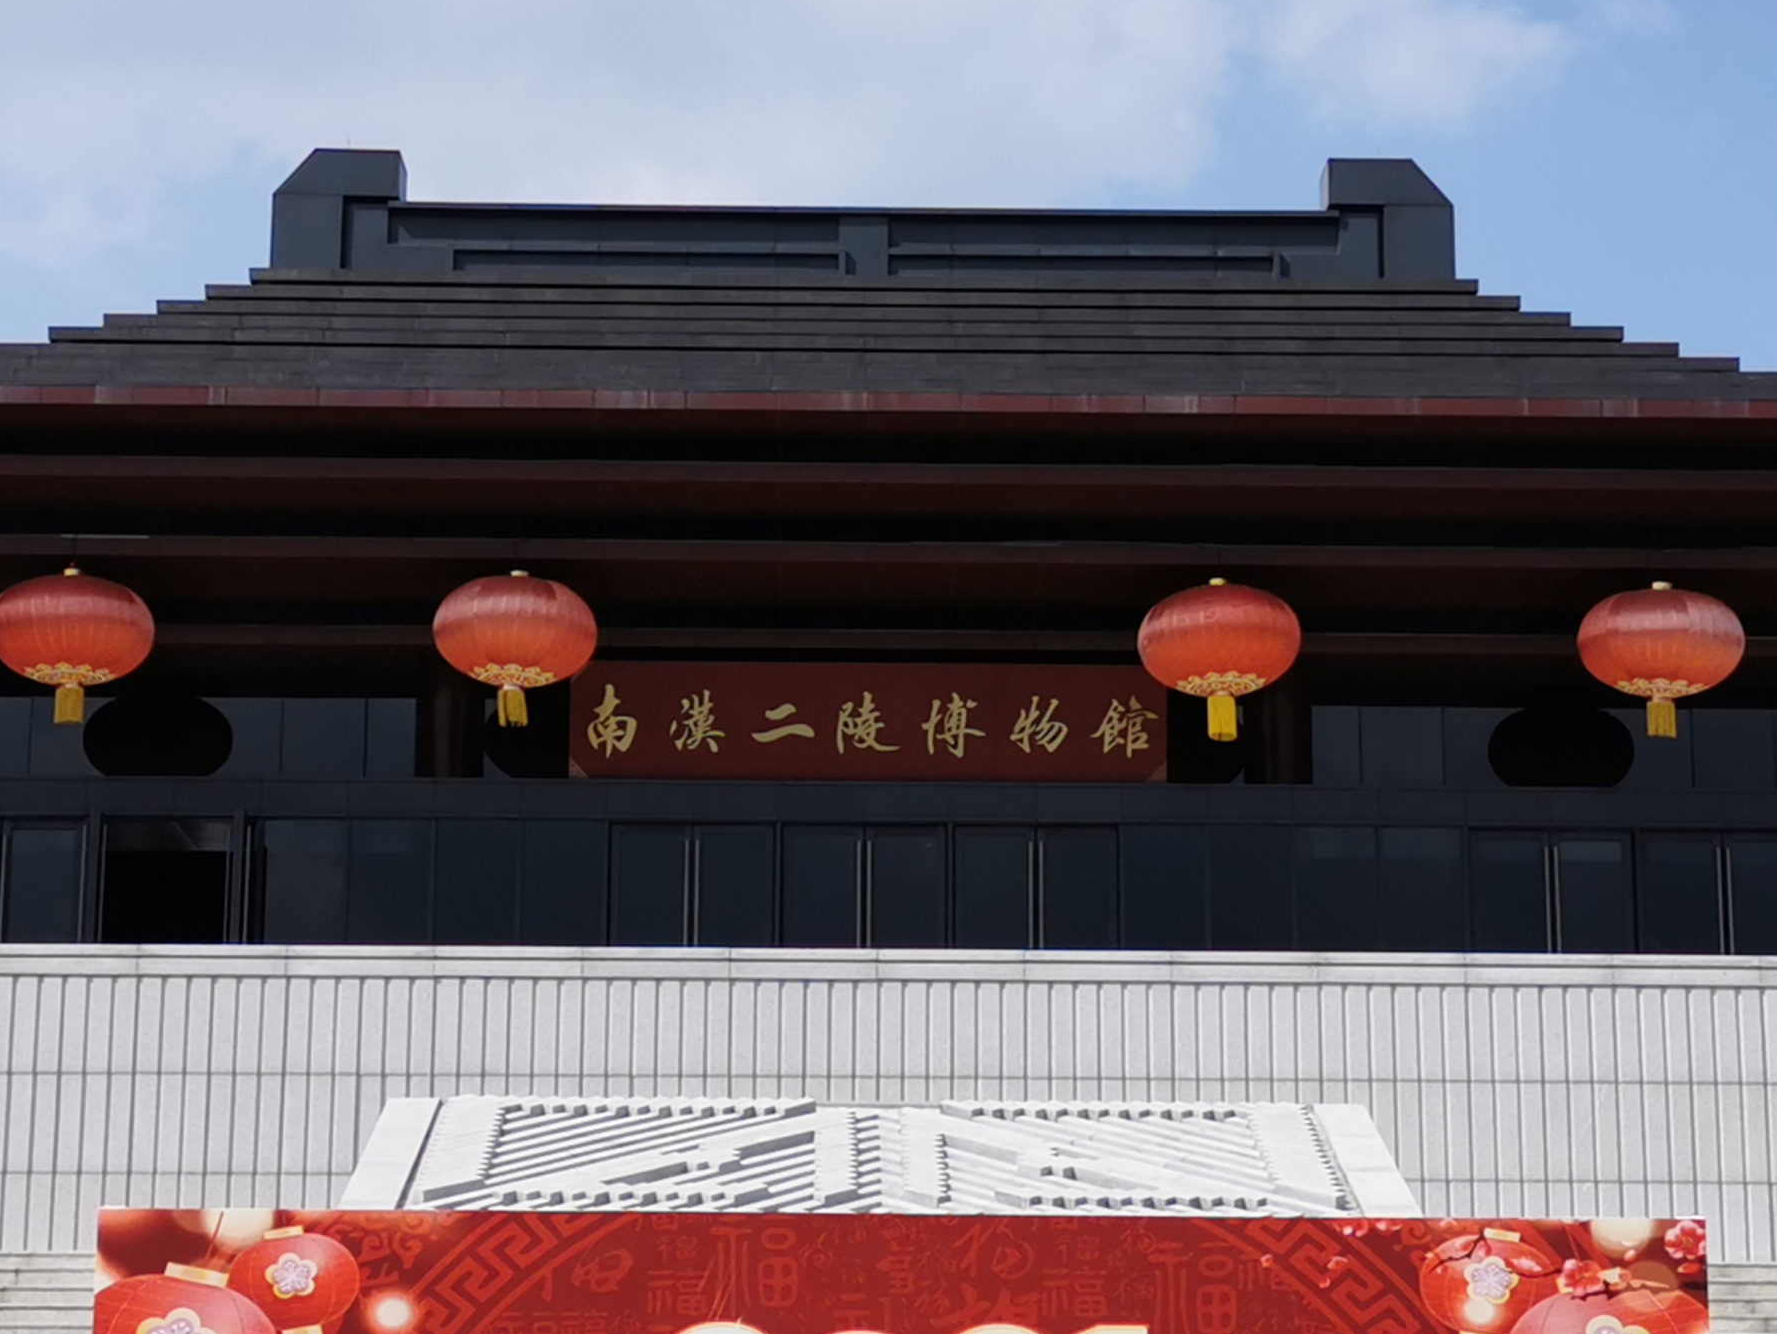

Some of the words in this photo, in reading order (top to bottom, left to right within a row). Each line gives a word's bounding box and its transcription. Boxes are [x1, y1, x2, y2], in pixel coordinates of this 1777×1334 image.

[586, 683, 1160, 759] 南漢二陵博物館
